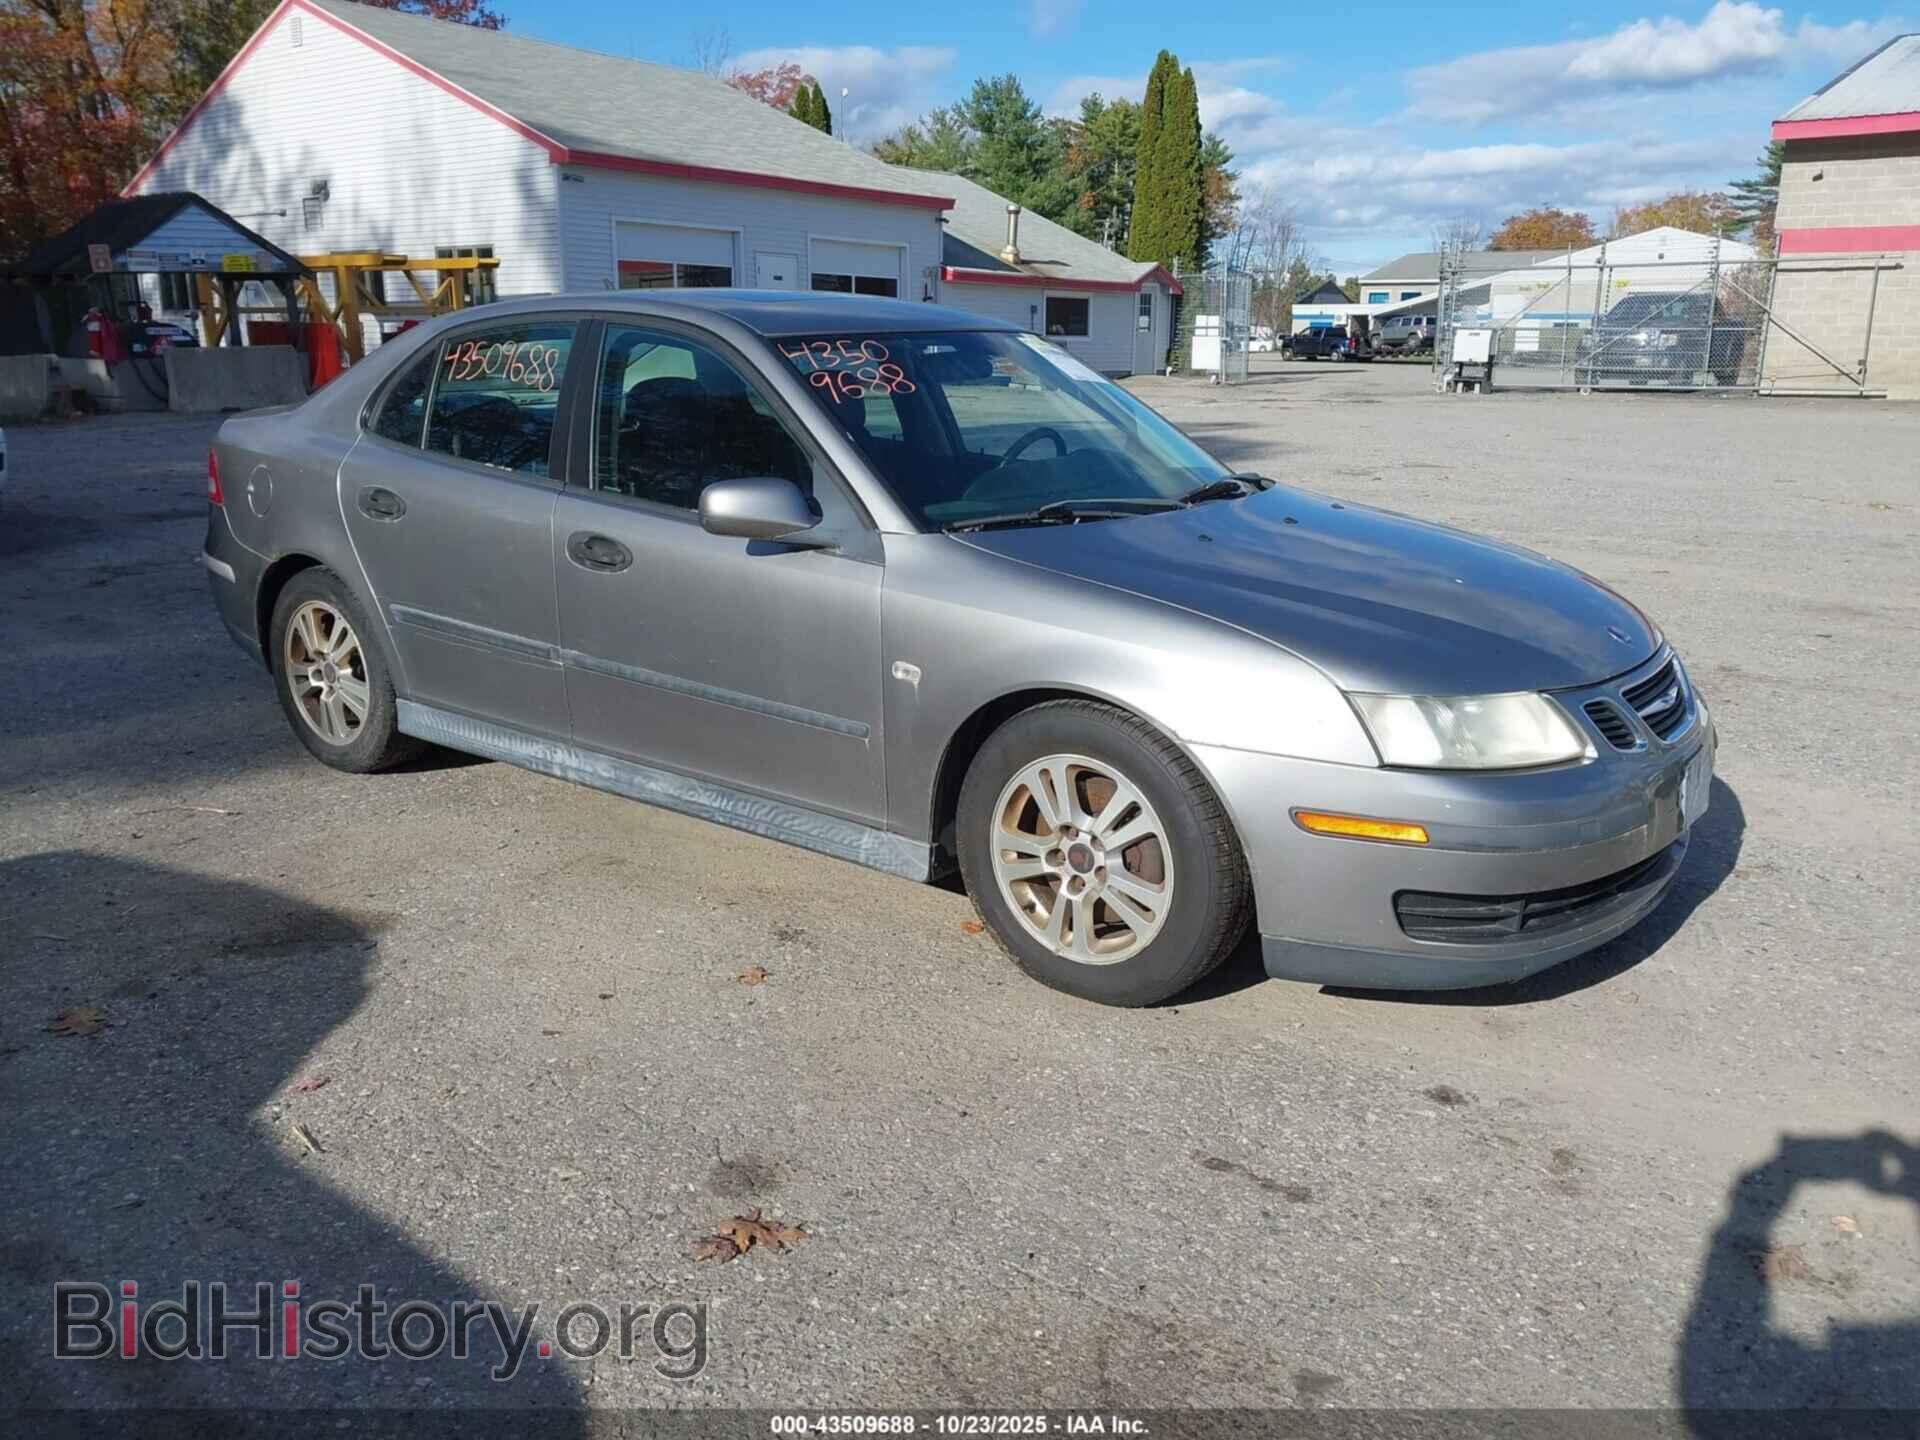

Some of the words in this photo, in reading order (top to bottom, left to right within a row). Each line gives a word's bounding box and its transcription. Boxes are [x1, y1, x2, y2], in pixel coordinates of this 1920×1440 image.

[445, 341, 560, 392] 43509688
[777, 340, 889, 369] 4350
[810, 363, 916, 404] 9688
